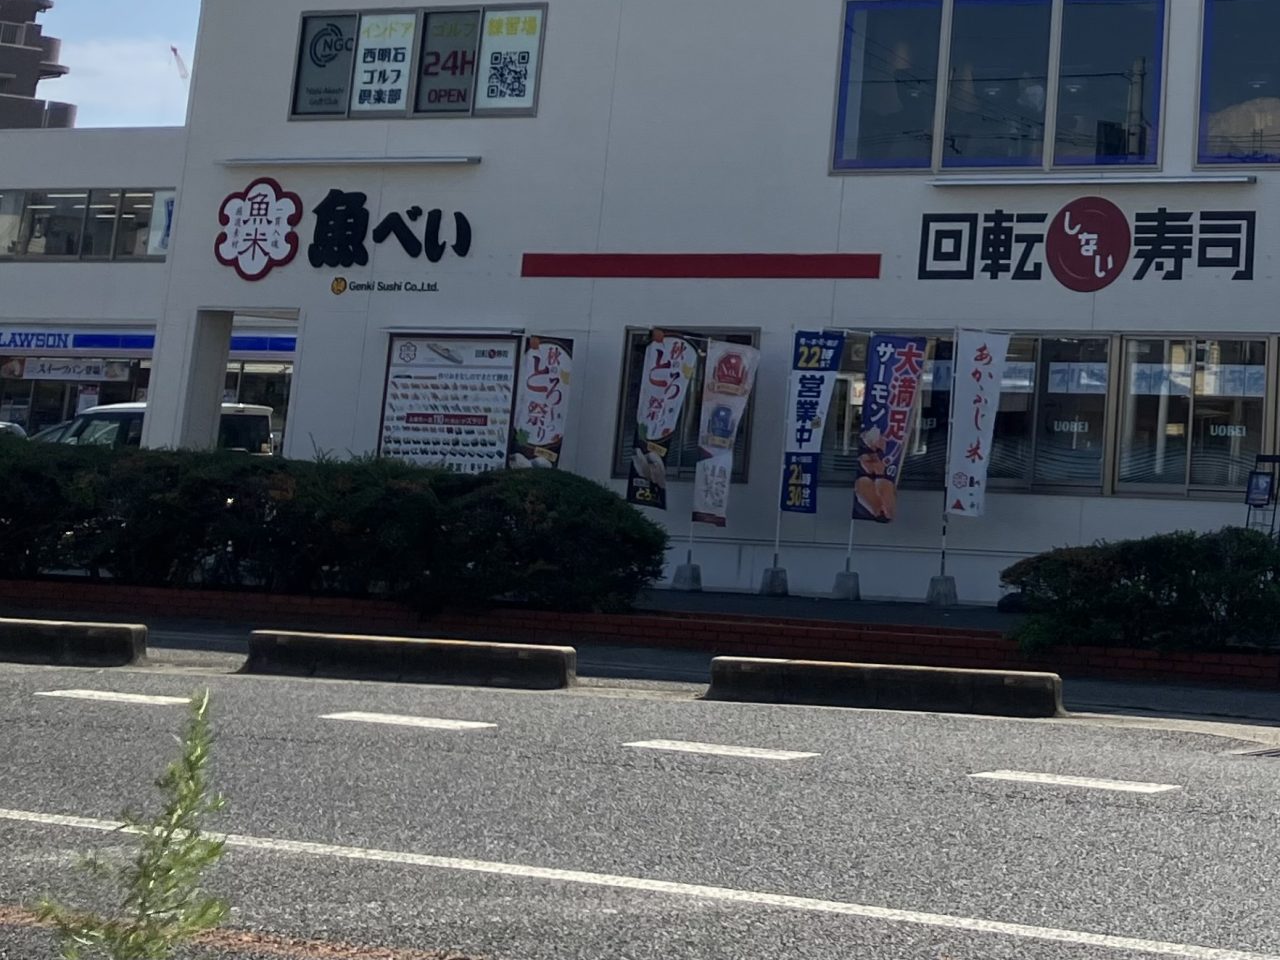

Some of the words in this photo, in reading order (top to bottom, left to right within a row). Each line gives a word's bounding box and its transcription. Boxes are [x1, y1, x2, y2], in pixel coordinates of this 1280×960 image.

[362, 46, 407, 64] 西明石
[362, 68, 402, 85] ゴルフ
[358, 88, 402, 105] 倶楽部
[427, 88, 467, 104] OPEN
[308, 189, 472, 268] 魚べい
[349, 280, 375, 292] Genki
[377, 280, 402, 292] Sushi
[0, 332, 70, 348] LAWSON
[870, 342, 895, 423] サーモン
[796, 374, 825, 449] 営業中
[1053, 420, 1089, 433] UOBEI
[1209, 424, 1247, 437] UOBEI
